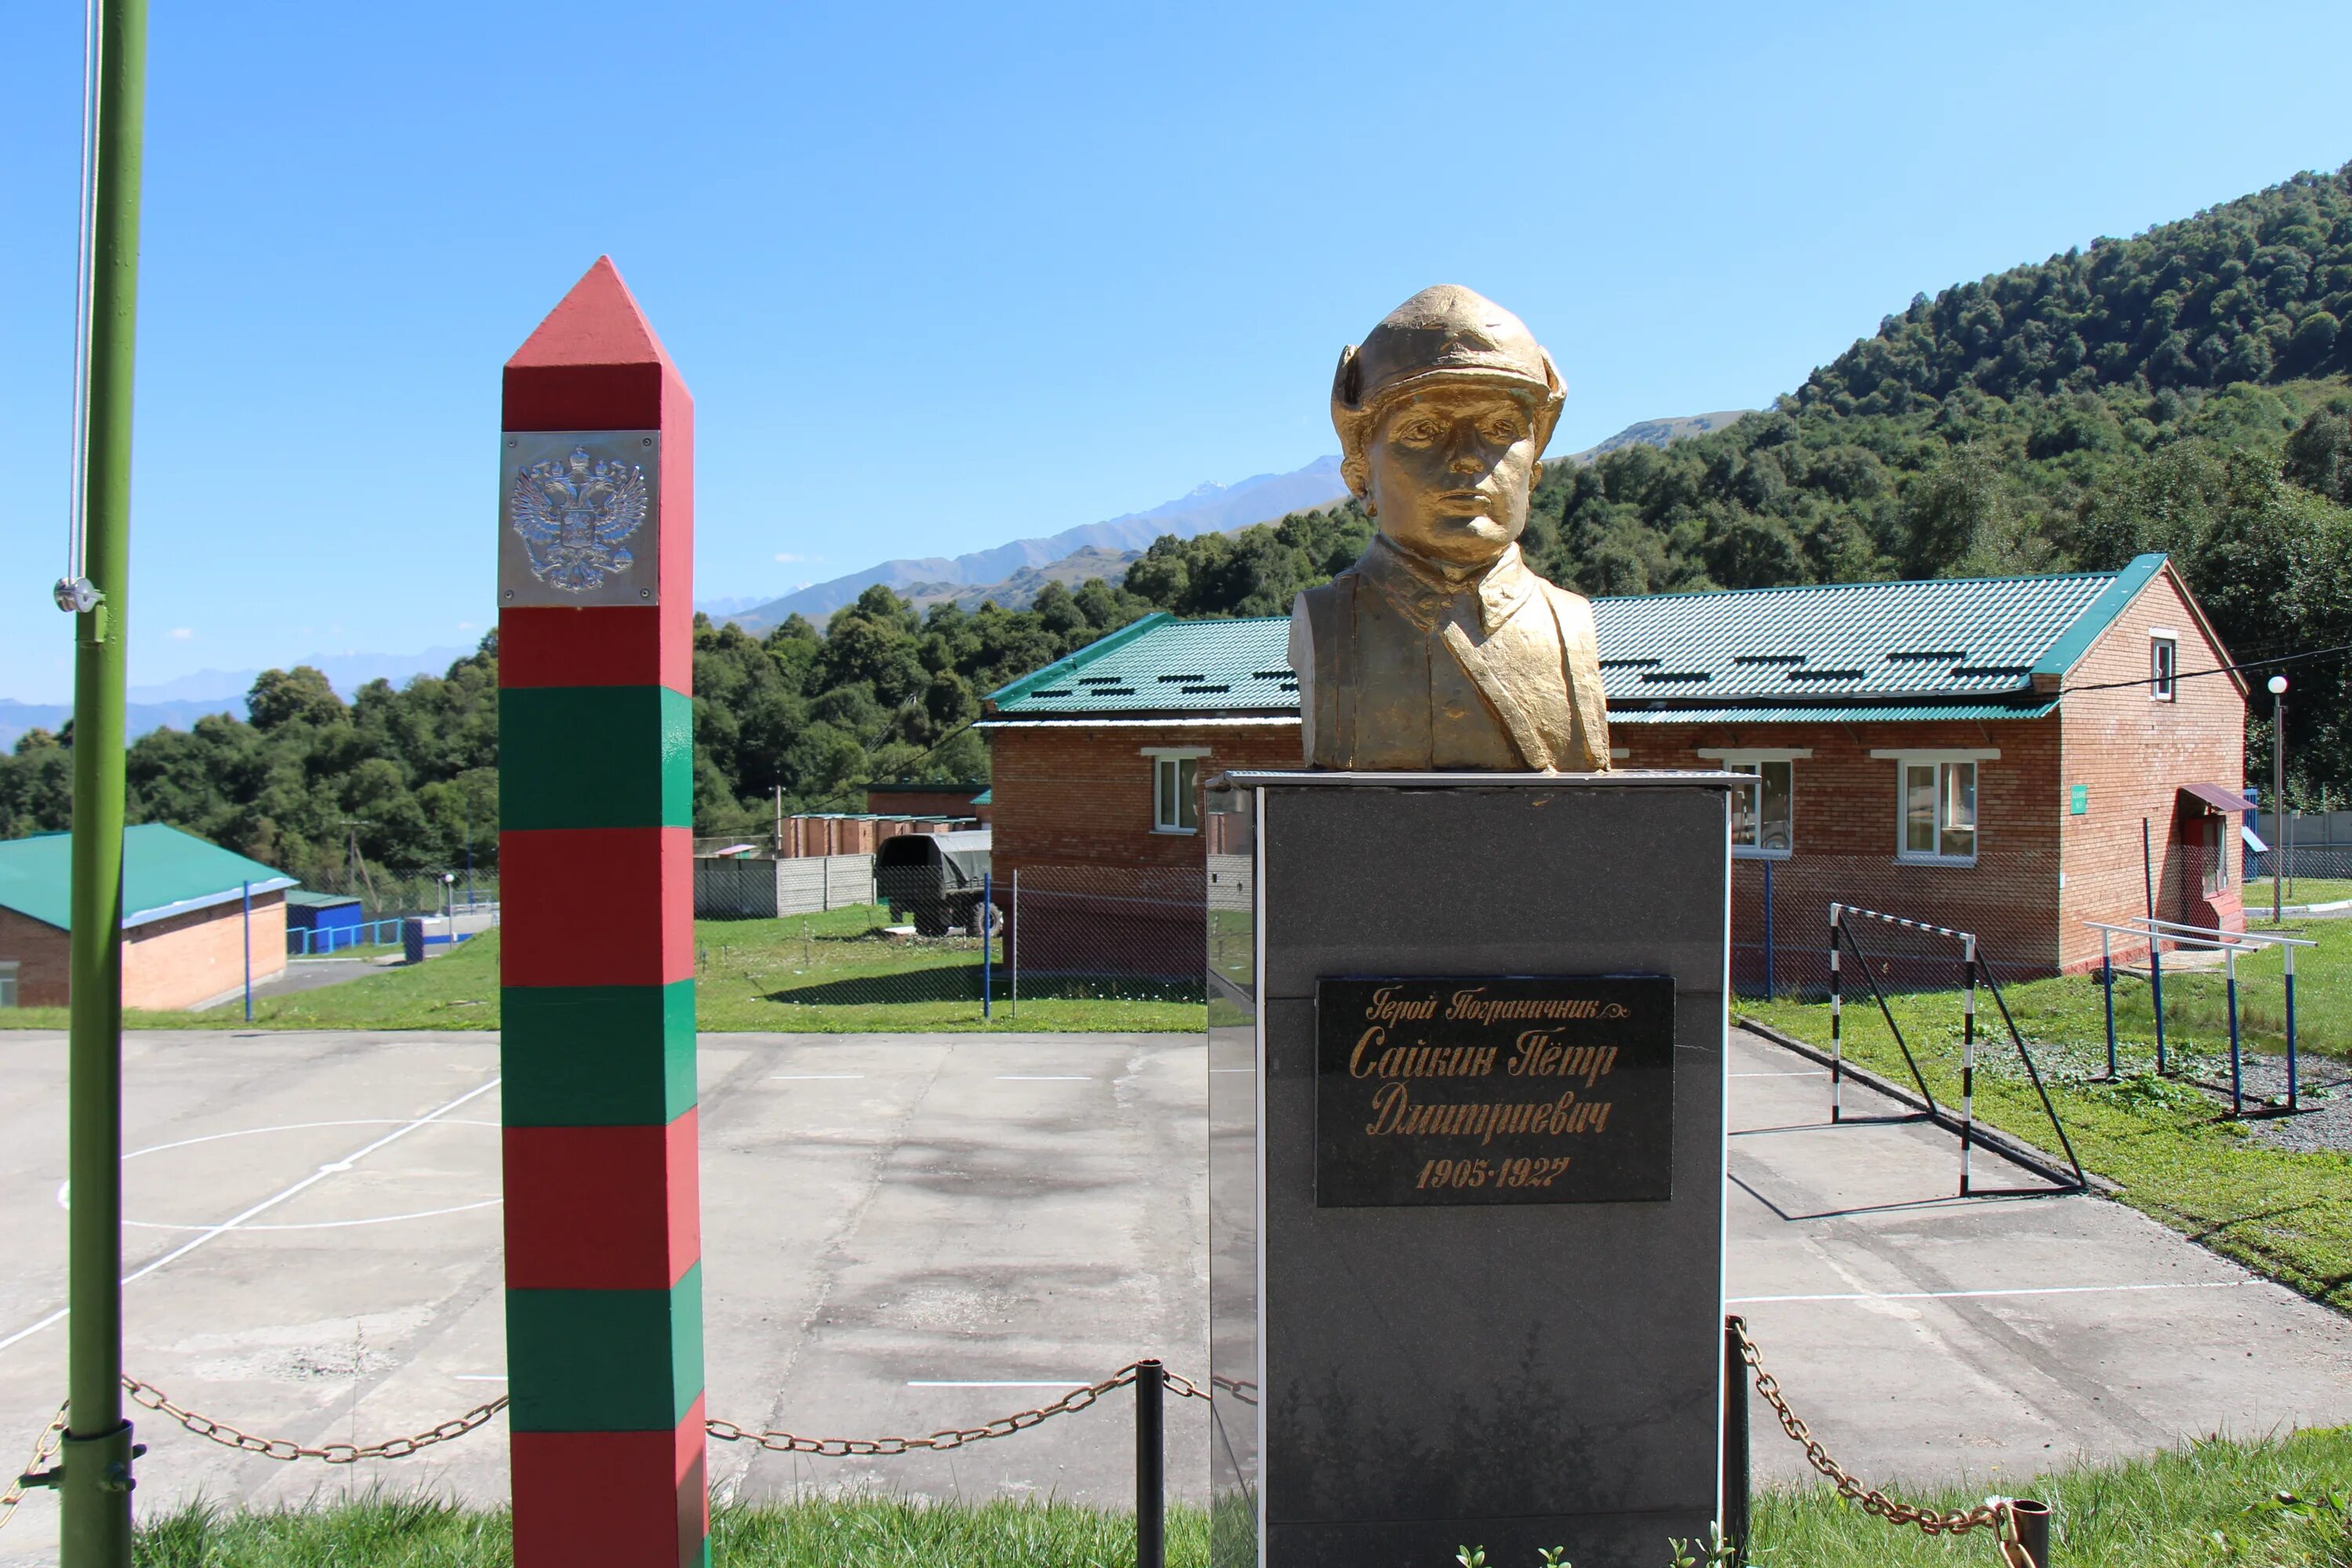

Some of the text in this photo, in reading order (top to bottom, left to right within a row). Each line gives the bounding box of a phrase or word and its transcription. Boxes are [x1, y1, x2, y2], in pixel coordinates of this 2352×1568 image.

[1367, 985, 1600, 1029] Герой Пограничник
[1349, 1026, 1618, 1087] Сайкин Пётр
[1366, 1080, 1612, 1145] Дмитриевич
